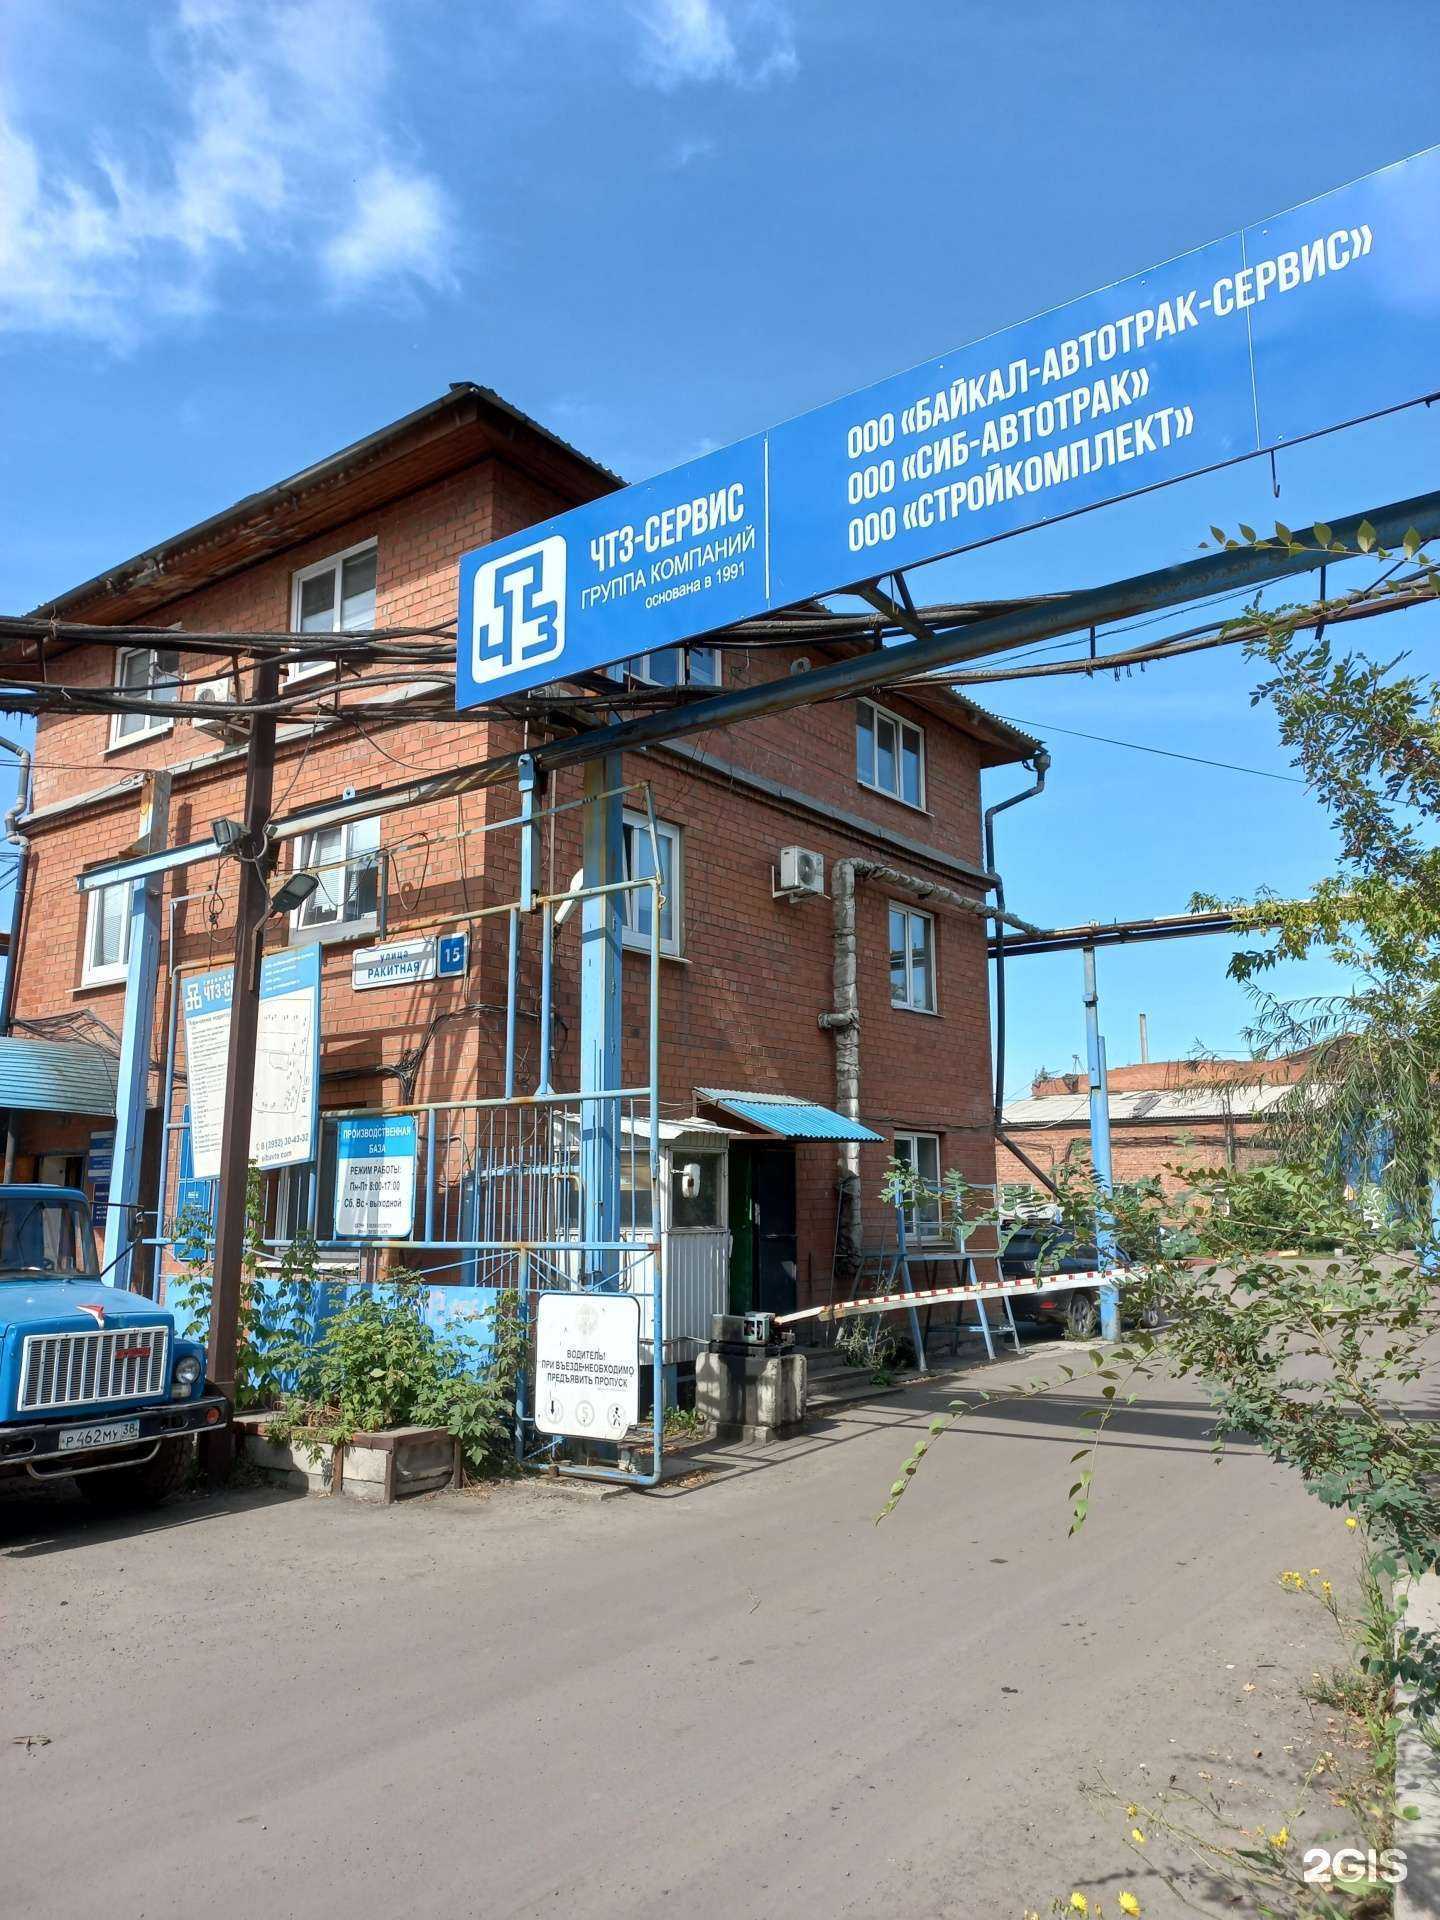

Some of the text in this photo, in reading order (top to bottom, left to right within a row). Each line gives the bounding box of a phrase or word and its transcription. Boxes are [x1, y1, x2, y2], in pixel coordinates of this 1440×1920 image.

[847, 224, 1373, 459] ООО «БАЙКАЛ-АВТОТРАК-СЕРВИС»
[847, 367, 1150, 505] ООО «СИБ-АВТОТРАК»
[847, 406, 1195, 553] ООО «СТРОЙКОМПЛЕКТ»
[589, 482, 744, 572] ЧТЗ-СЕРВИС
[581, 525, 755, 610] ГРУППА КОМПАНИЙ
[645, 561, 745, 609] основана в 1991
[380, 950, 409, 964] улица
[445, 947, 461, 963] 15
[368, 961, 420, 979] РАКИТНАЯ
[343, 1126, 412, 1139] ПРОИЗВОДСТВЕННАЯ
[368, 1144, 386, 1153] БАЗА
[350, 1166, 372, 1175] РЕЖИМ
[369, 1198, 402, 1208] выходной
[566, 1349, 606, 1360] ВОДИТЕЛЬ!
[541, 1360, 555, 1369] ПРИ
[584, 1363, 635, 1376] НЕОБХОДИМО
[547, 1372, 628, 1388] ПРЕДЪЯВИТЬ ПРОПУСК
